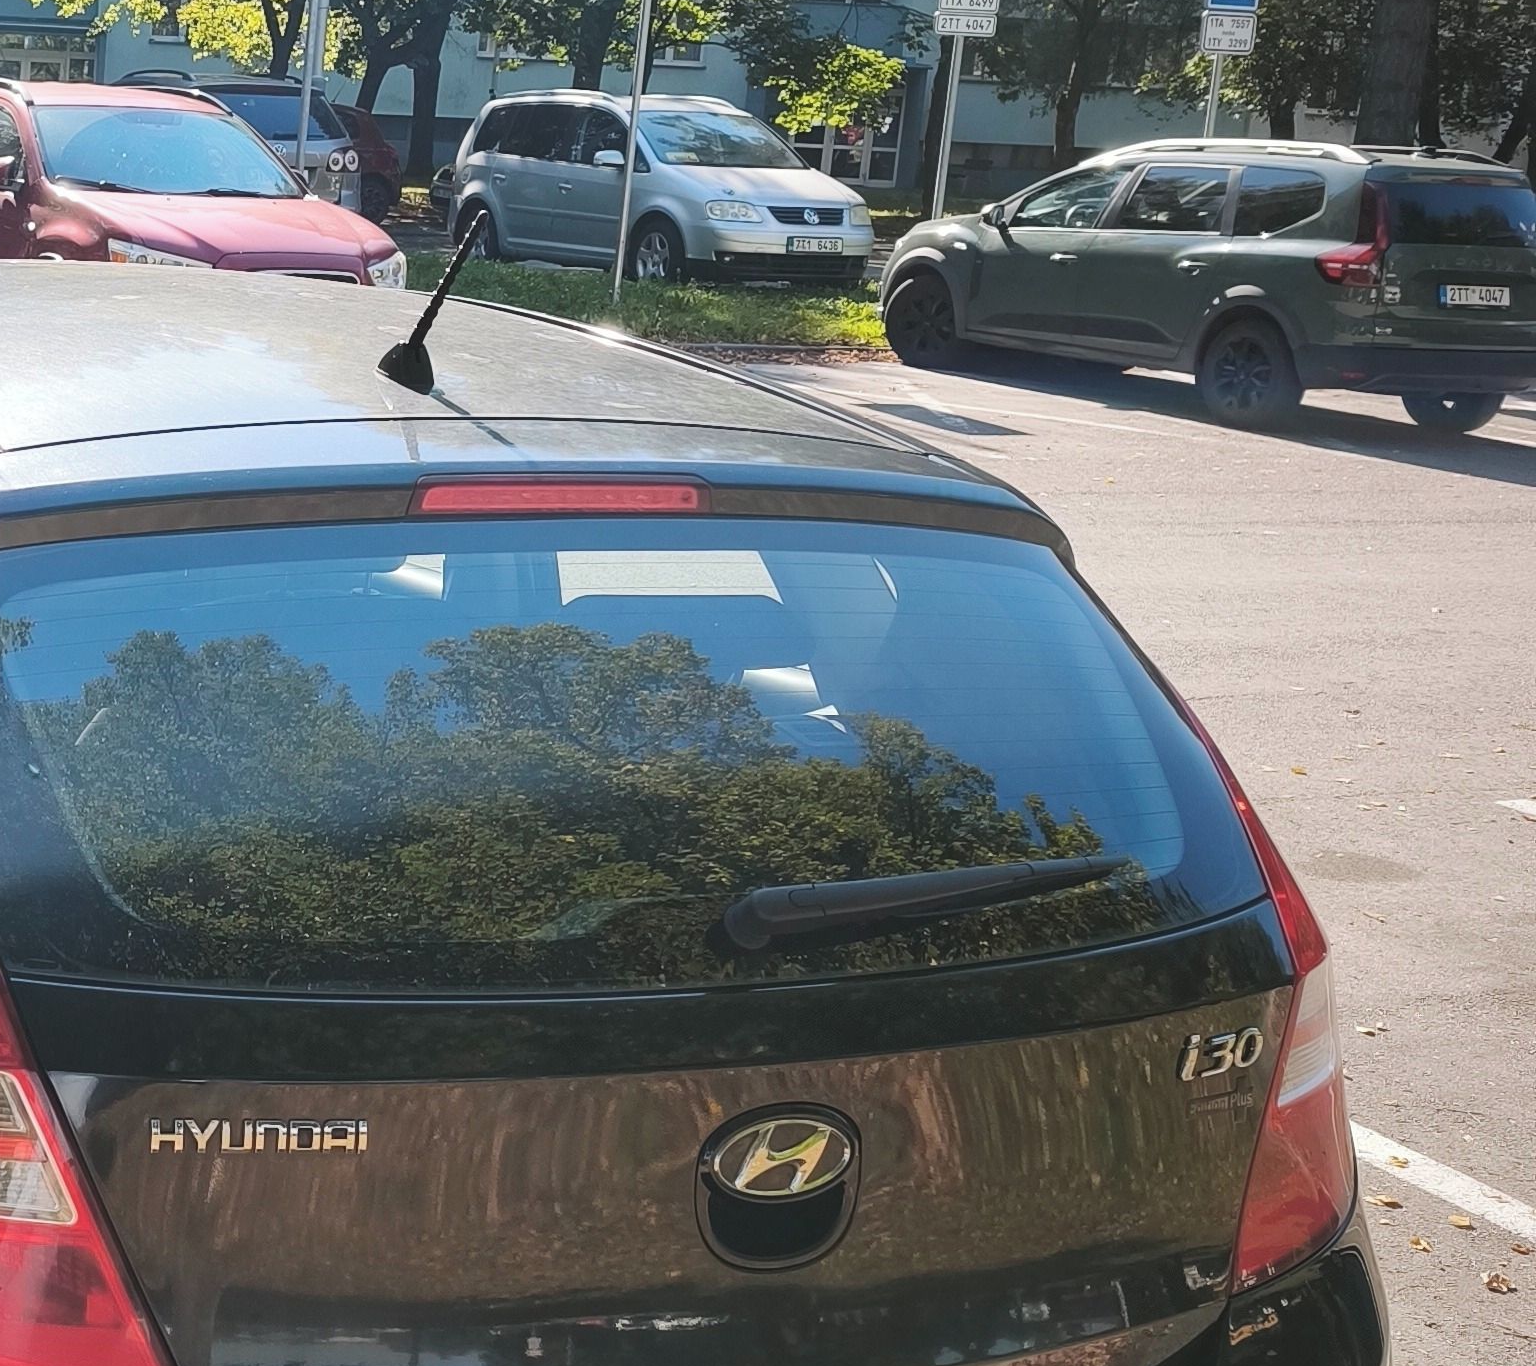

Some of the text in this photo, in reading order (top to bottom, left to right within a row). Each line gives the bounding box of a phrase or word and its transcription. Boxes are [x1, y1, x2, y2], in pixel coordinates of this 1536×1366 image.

[941, 18, 992, 31] 2TT 4047
[1210, 18, 1251, 29] 1TA 7557
[1450, 288, 1504, 303] 2TT 4047
[1178, 1027, 1263, 1081] i30
[150, 1119, 368, 1154] HYUNDAI
